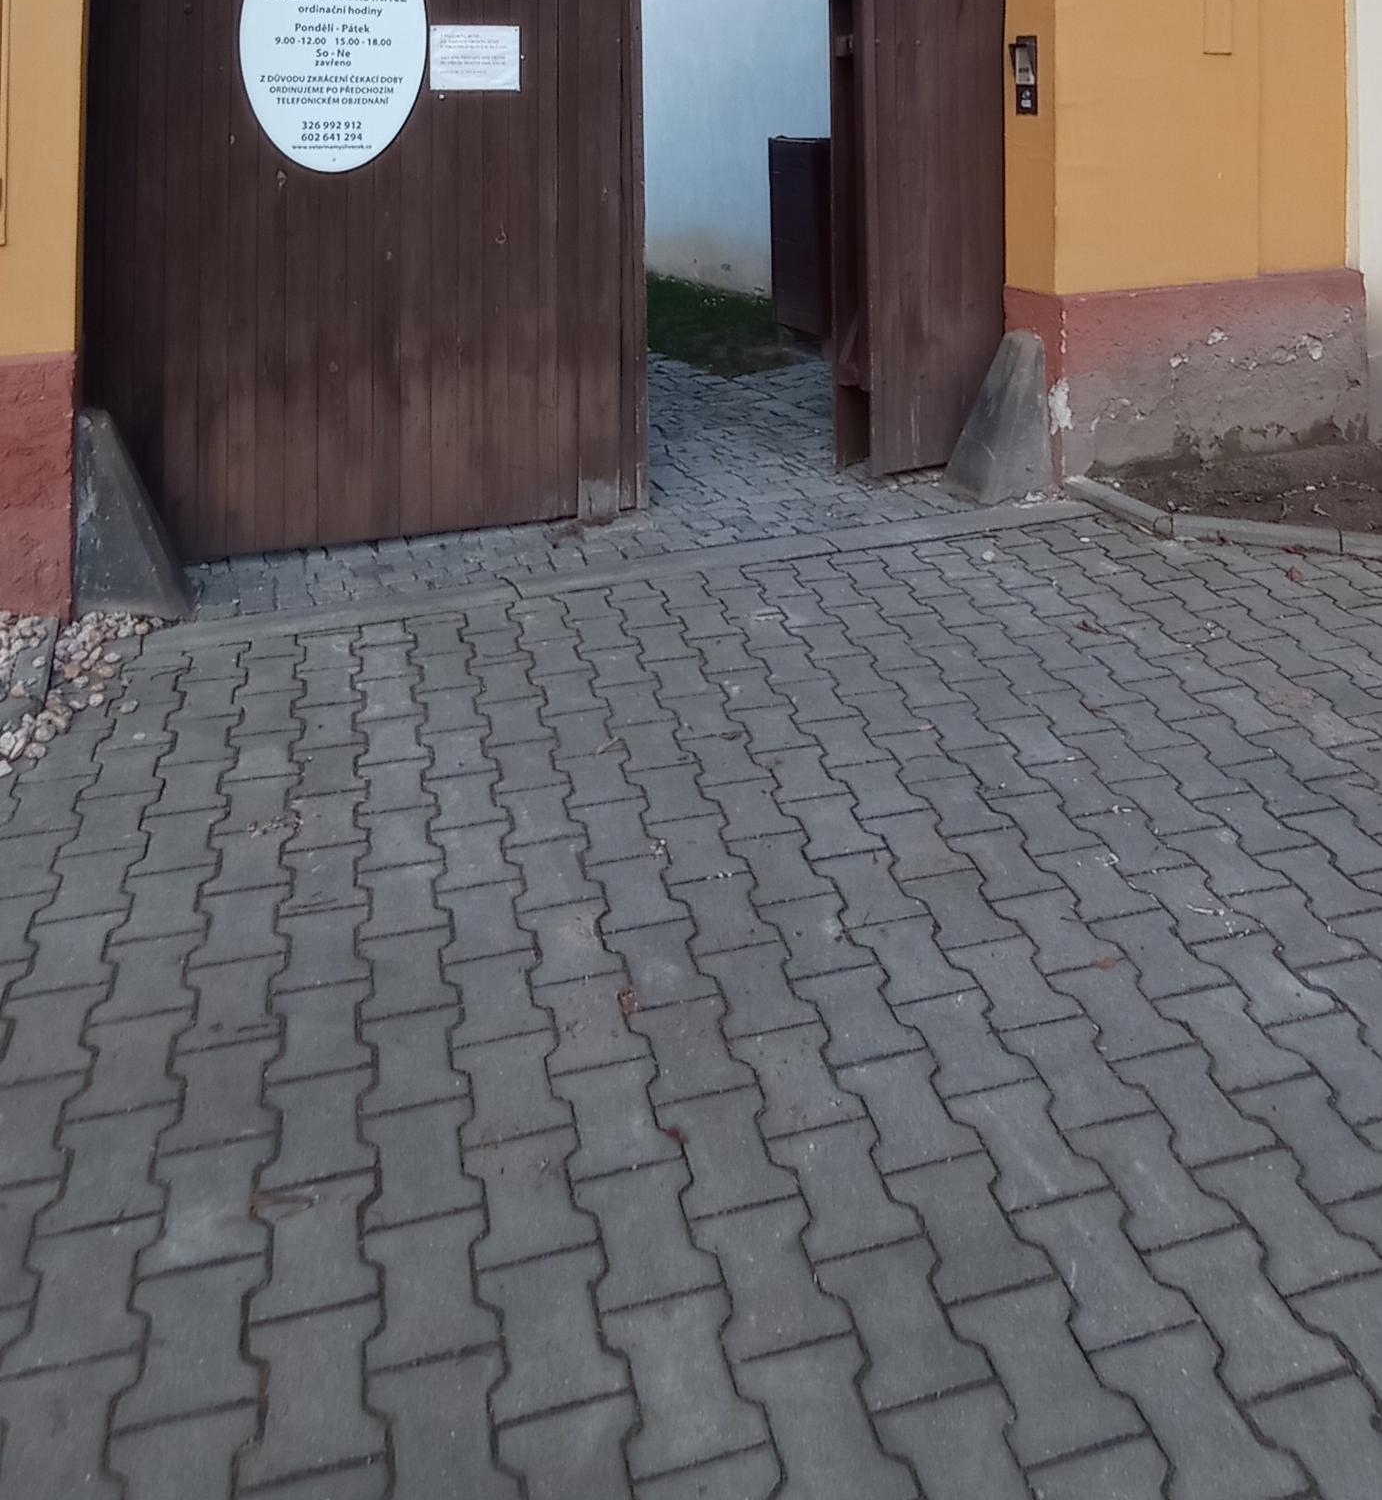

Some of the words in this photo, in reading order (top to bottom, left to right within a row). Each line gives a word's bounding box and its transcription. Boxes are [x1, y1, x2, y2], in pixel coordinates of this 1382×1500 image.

[298, 5, 346, 14] ordinační
[348, 6, 383, 17] hodiny
[294, 23, 334, 33] Pondělí
[341, 24, 370, 33] Pátek
[275, 36, 296, 45] 9.00
[335, 37, 360, 46] 15.00
[367, 38, 392, 46] 18.00
[315, 48, 329, 58] So
[336, 49, 351, 58] Ne
[314, 58, 352, 67] zavřeno
[260, 75, 266, 83] Z
[268, 74, 305, 83] DŮVODU
[307, 75, 348, 83] ZKRÁCENÍ
[349, 75, 379, 83] ČEKACÍ
[380, 76, 404, 84] DOBY
[269, 86, 324, 94] ORDINUJEME
[326, 86, 338, 94] PO
[340, 86, 394, 94] PŘEDCHOZÍM
[276, 96, 340, 105] TELEFONICKÉM
[341, 97, 389, 105] OBJEDNÁNÍ
[301, 121, 321, 130] 326
[322, 121, 342, 130] 992
[344, 121, 362, 130] 912
[301, 133, 320, 142] 602
[322, 133, 341, 142] 641
[344, 133, 363, 141] 294
